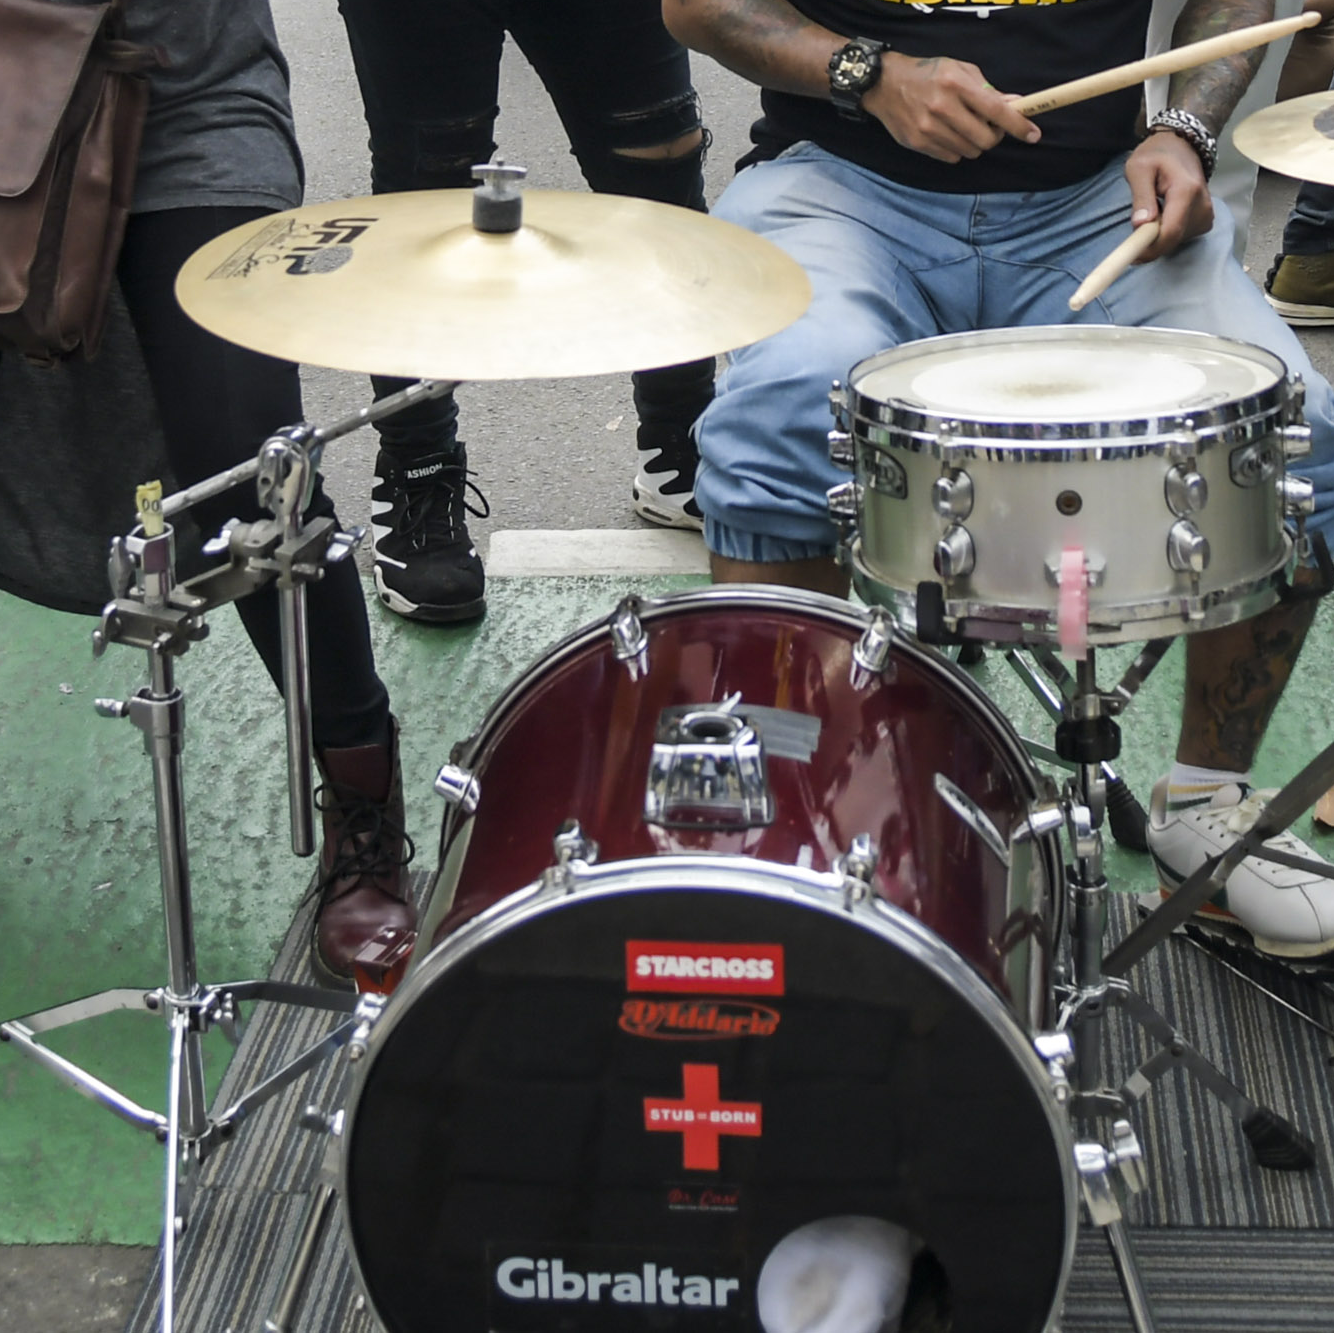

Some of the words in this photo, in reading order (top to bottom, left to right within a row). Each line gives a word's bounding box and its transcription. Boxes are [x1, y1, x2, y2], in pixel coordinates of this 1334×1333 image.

[404, 462, 443, 479] ASHION
[635, 954, 775, 981] STARCROSS
[496, 1256, 740, 1308] Gibraltar
